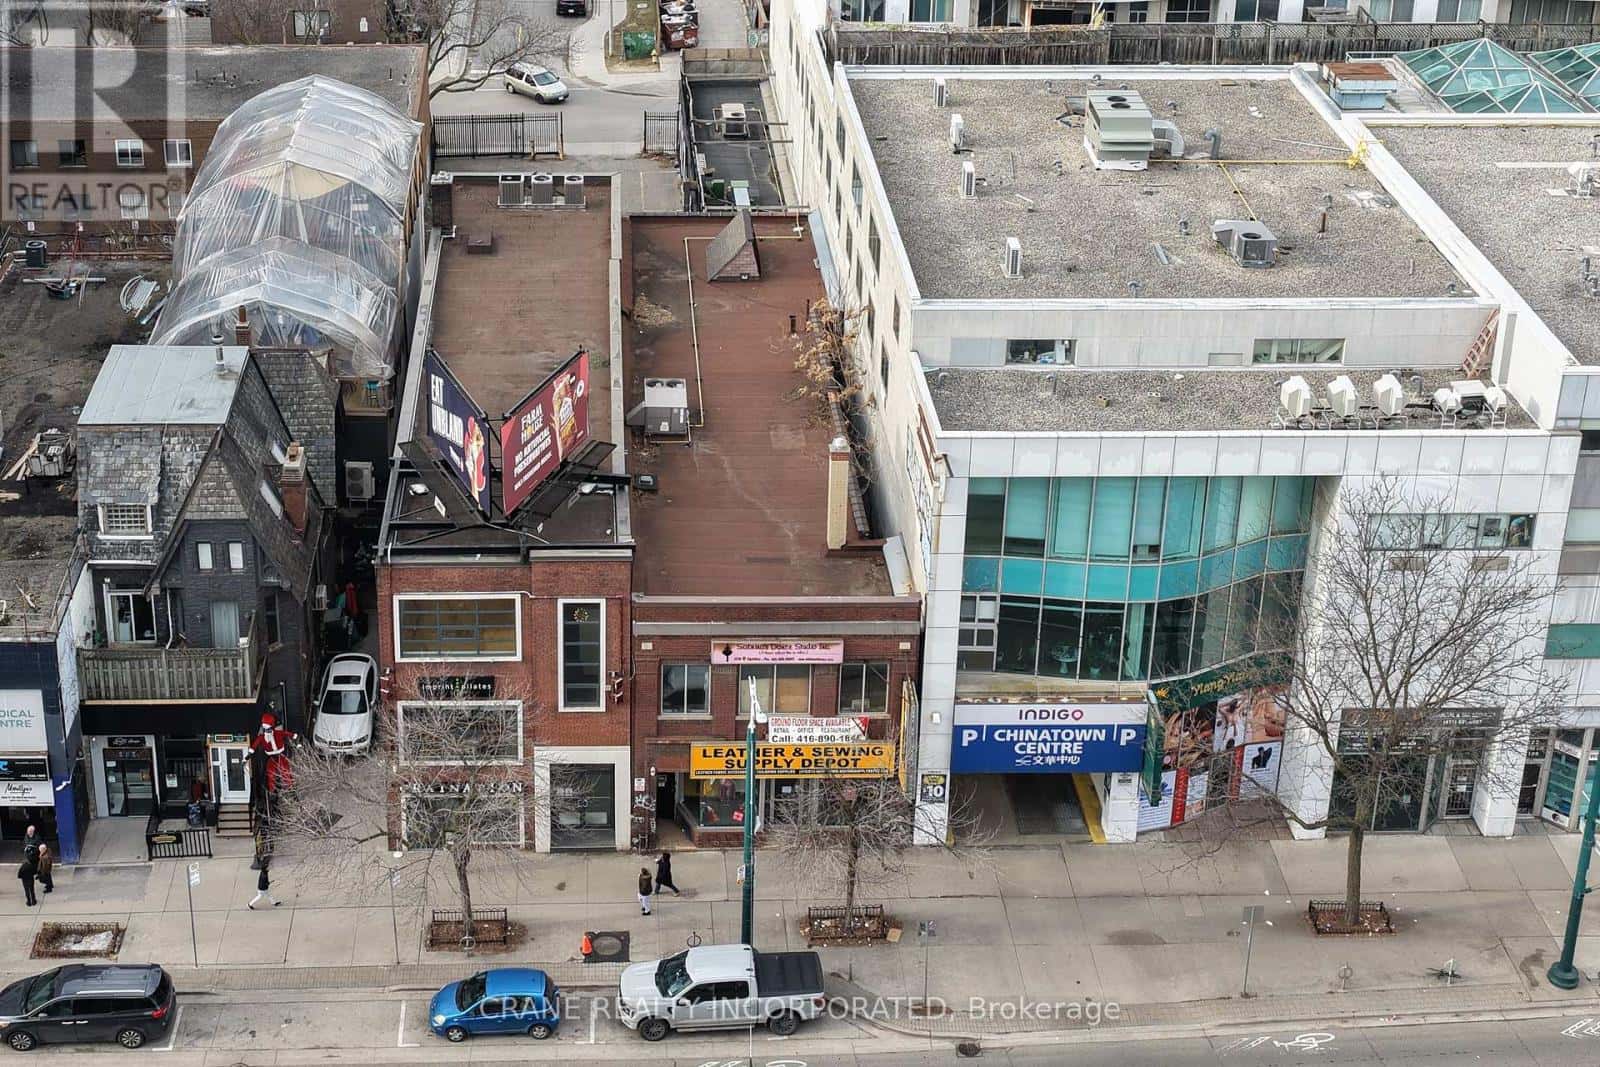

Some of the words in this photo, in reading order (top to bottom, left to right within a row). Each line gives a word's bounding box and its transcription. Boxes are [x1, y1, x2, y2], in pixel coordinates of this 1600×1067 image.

[431, 373, 444, 406] EAT
[795, 642, 817, 650] Studio
[1019, 709, 1084, 721] INDIGO
[792, 718, 808, 726] FLOOR
[809, 718, 824, 726] SPACE
[771, 735, 794, 743] Call:
[796, 735, 862, 744] 416-890-18
[961, 729, 979, 747] P
[993, 729, 1107, 742] CHINATOWN
[1119, 728, 1137, 746] P
[792, 747, 804, 757] &
[812, 746, 884, 757] SEWING
[1014, 742, 1084, 754] CENTRE
[801, 758, 861, 769] DEPOT
